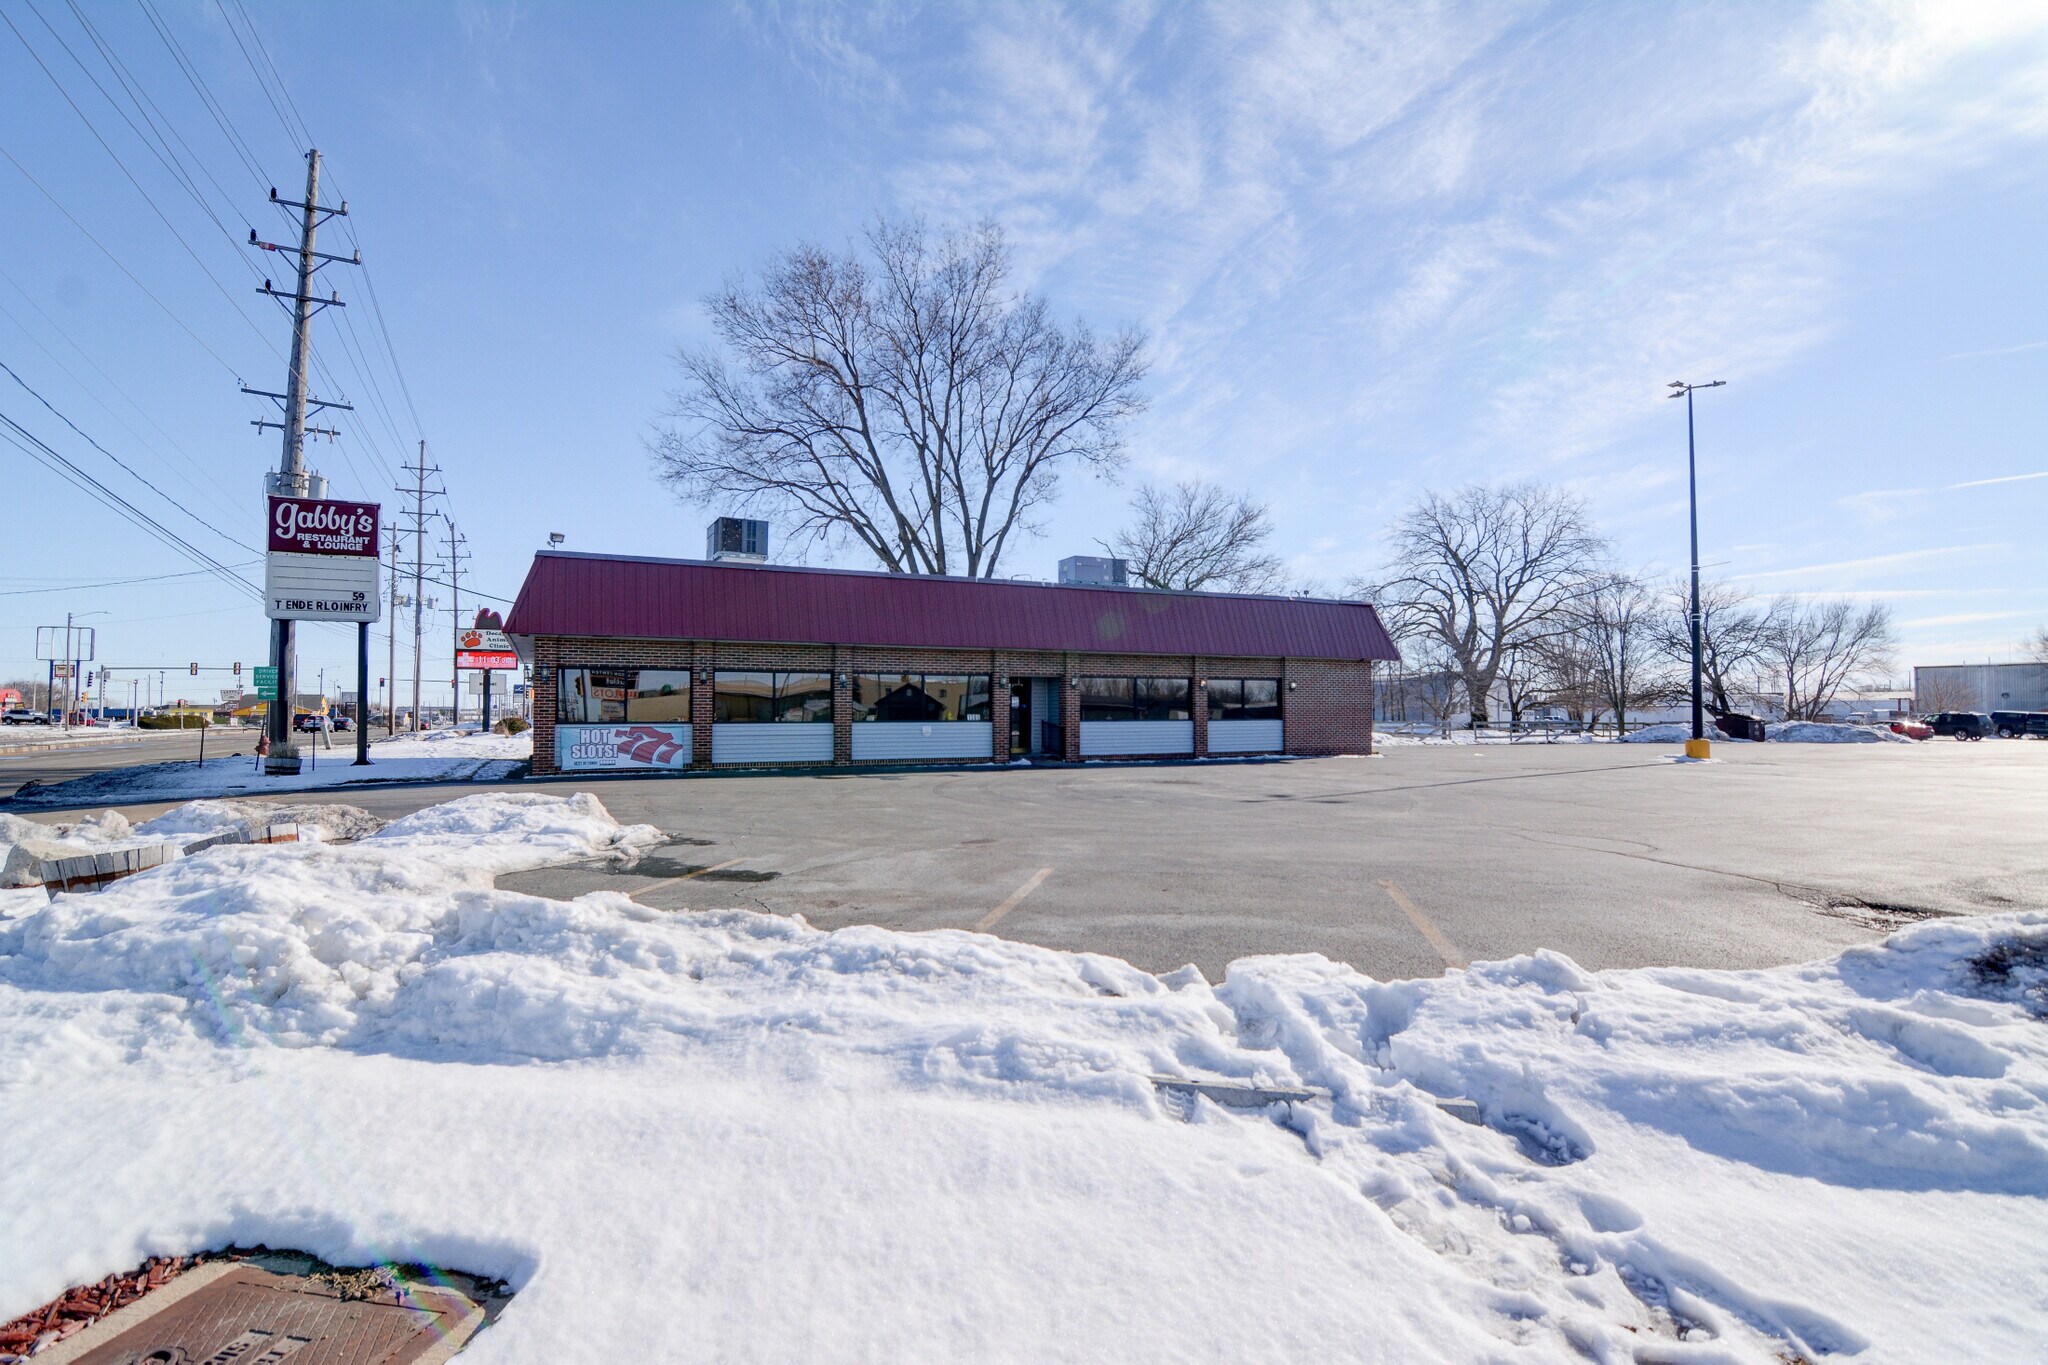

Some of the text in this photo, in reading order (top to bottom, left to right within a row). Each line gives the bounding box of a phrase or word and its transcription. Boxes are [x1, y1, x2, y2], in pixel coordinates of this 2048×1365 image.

[297, 533, 370, 544] RESTAURANT
[303, 541, 363, 551] & LOUNGE
[352, 592, 365, 601] 59
[580, 729, 611, 744] HOT
[571, 744, 619, 759] SLOTS!
